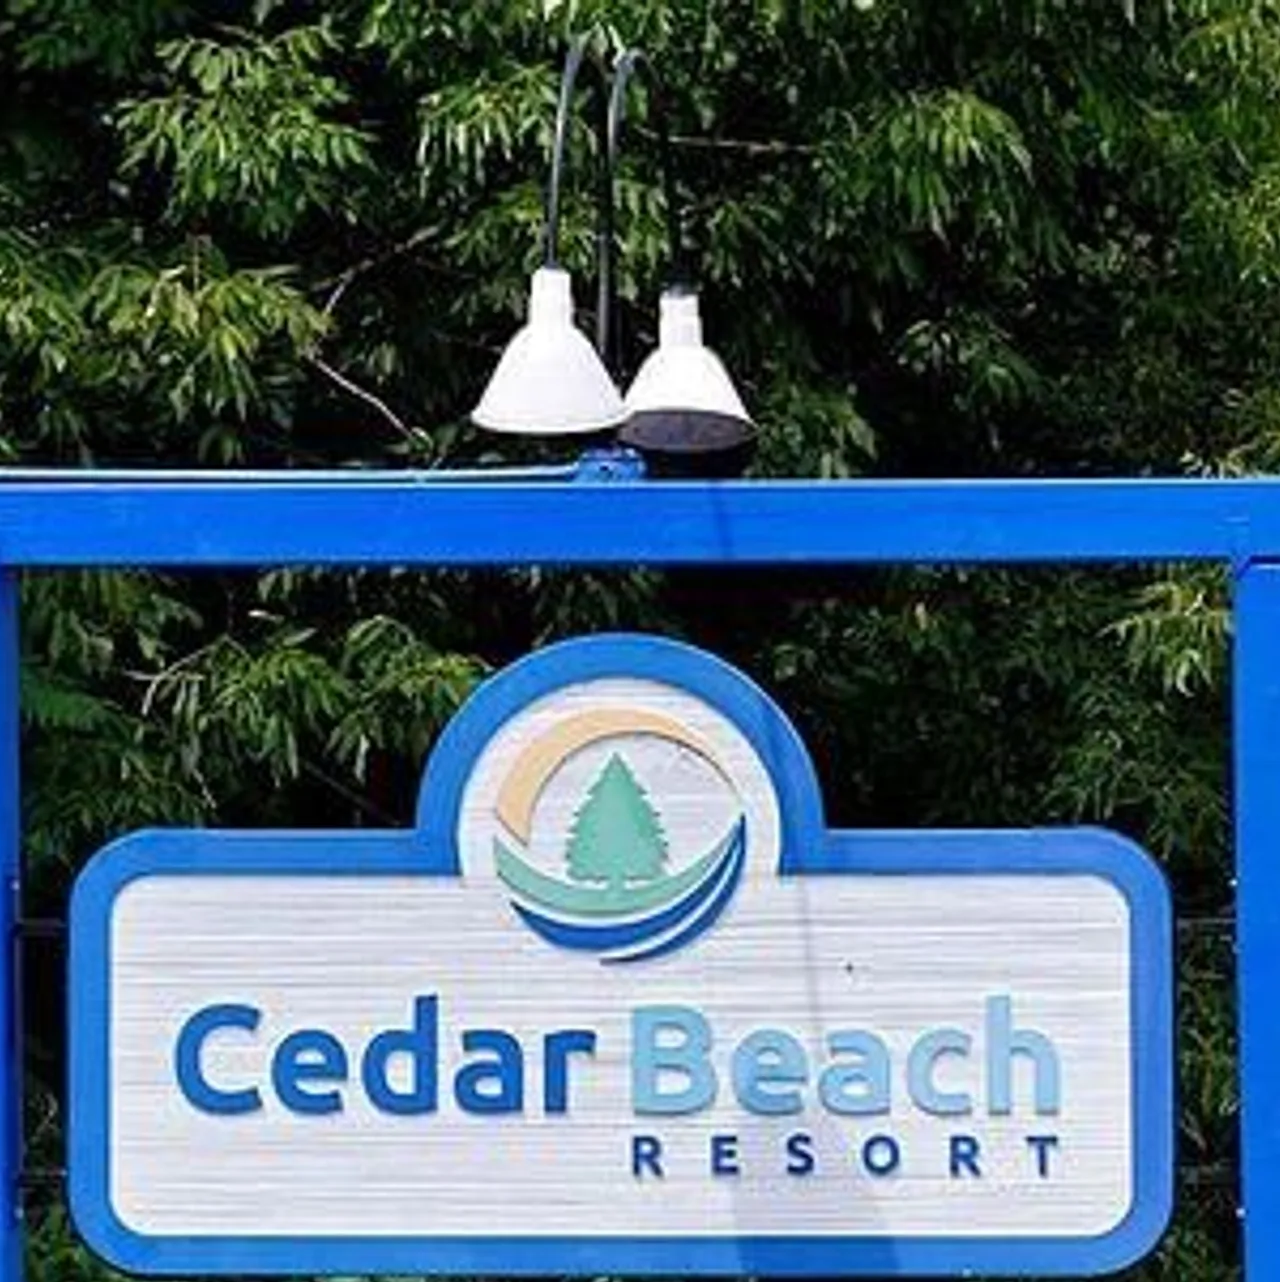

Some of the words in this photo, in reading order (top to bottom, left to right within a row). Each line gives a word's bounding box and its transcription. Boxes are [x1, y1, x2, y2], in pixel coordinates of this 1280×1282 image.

[173, 995, 596, 1118] Cedar
[631, 995, 1062, 1118] Beach
[632, 1135, 1061, 1178] RESORT
